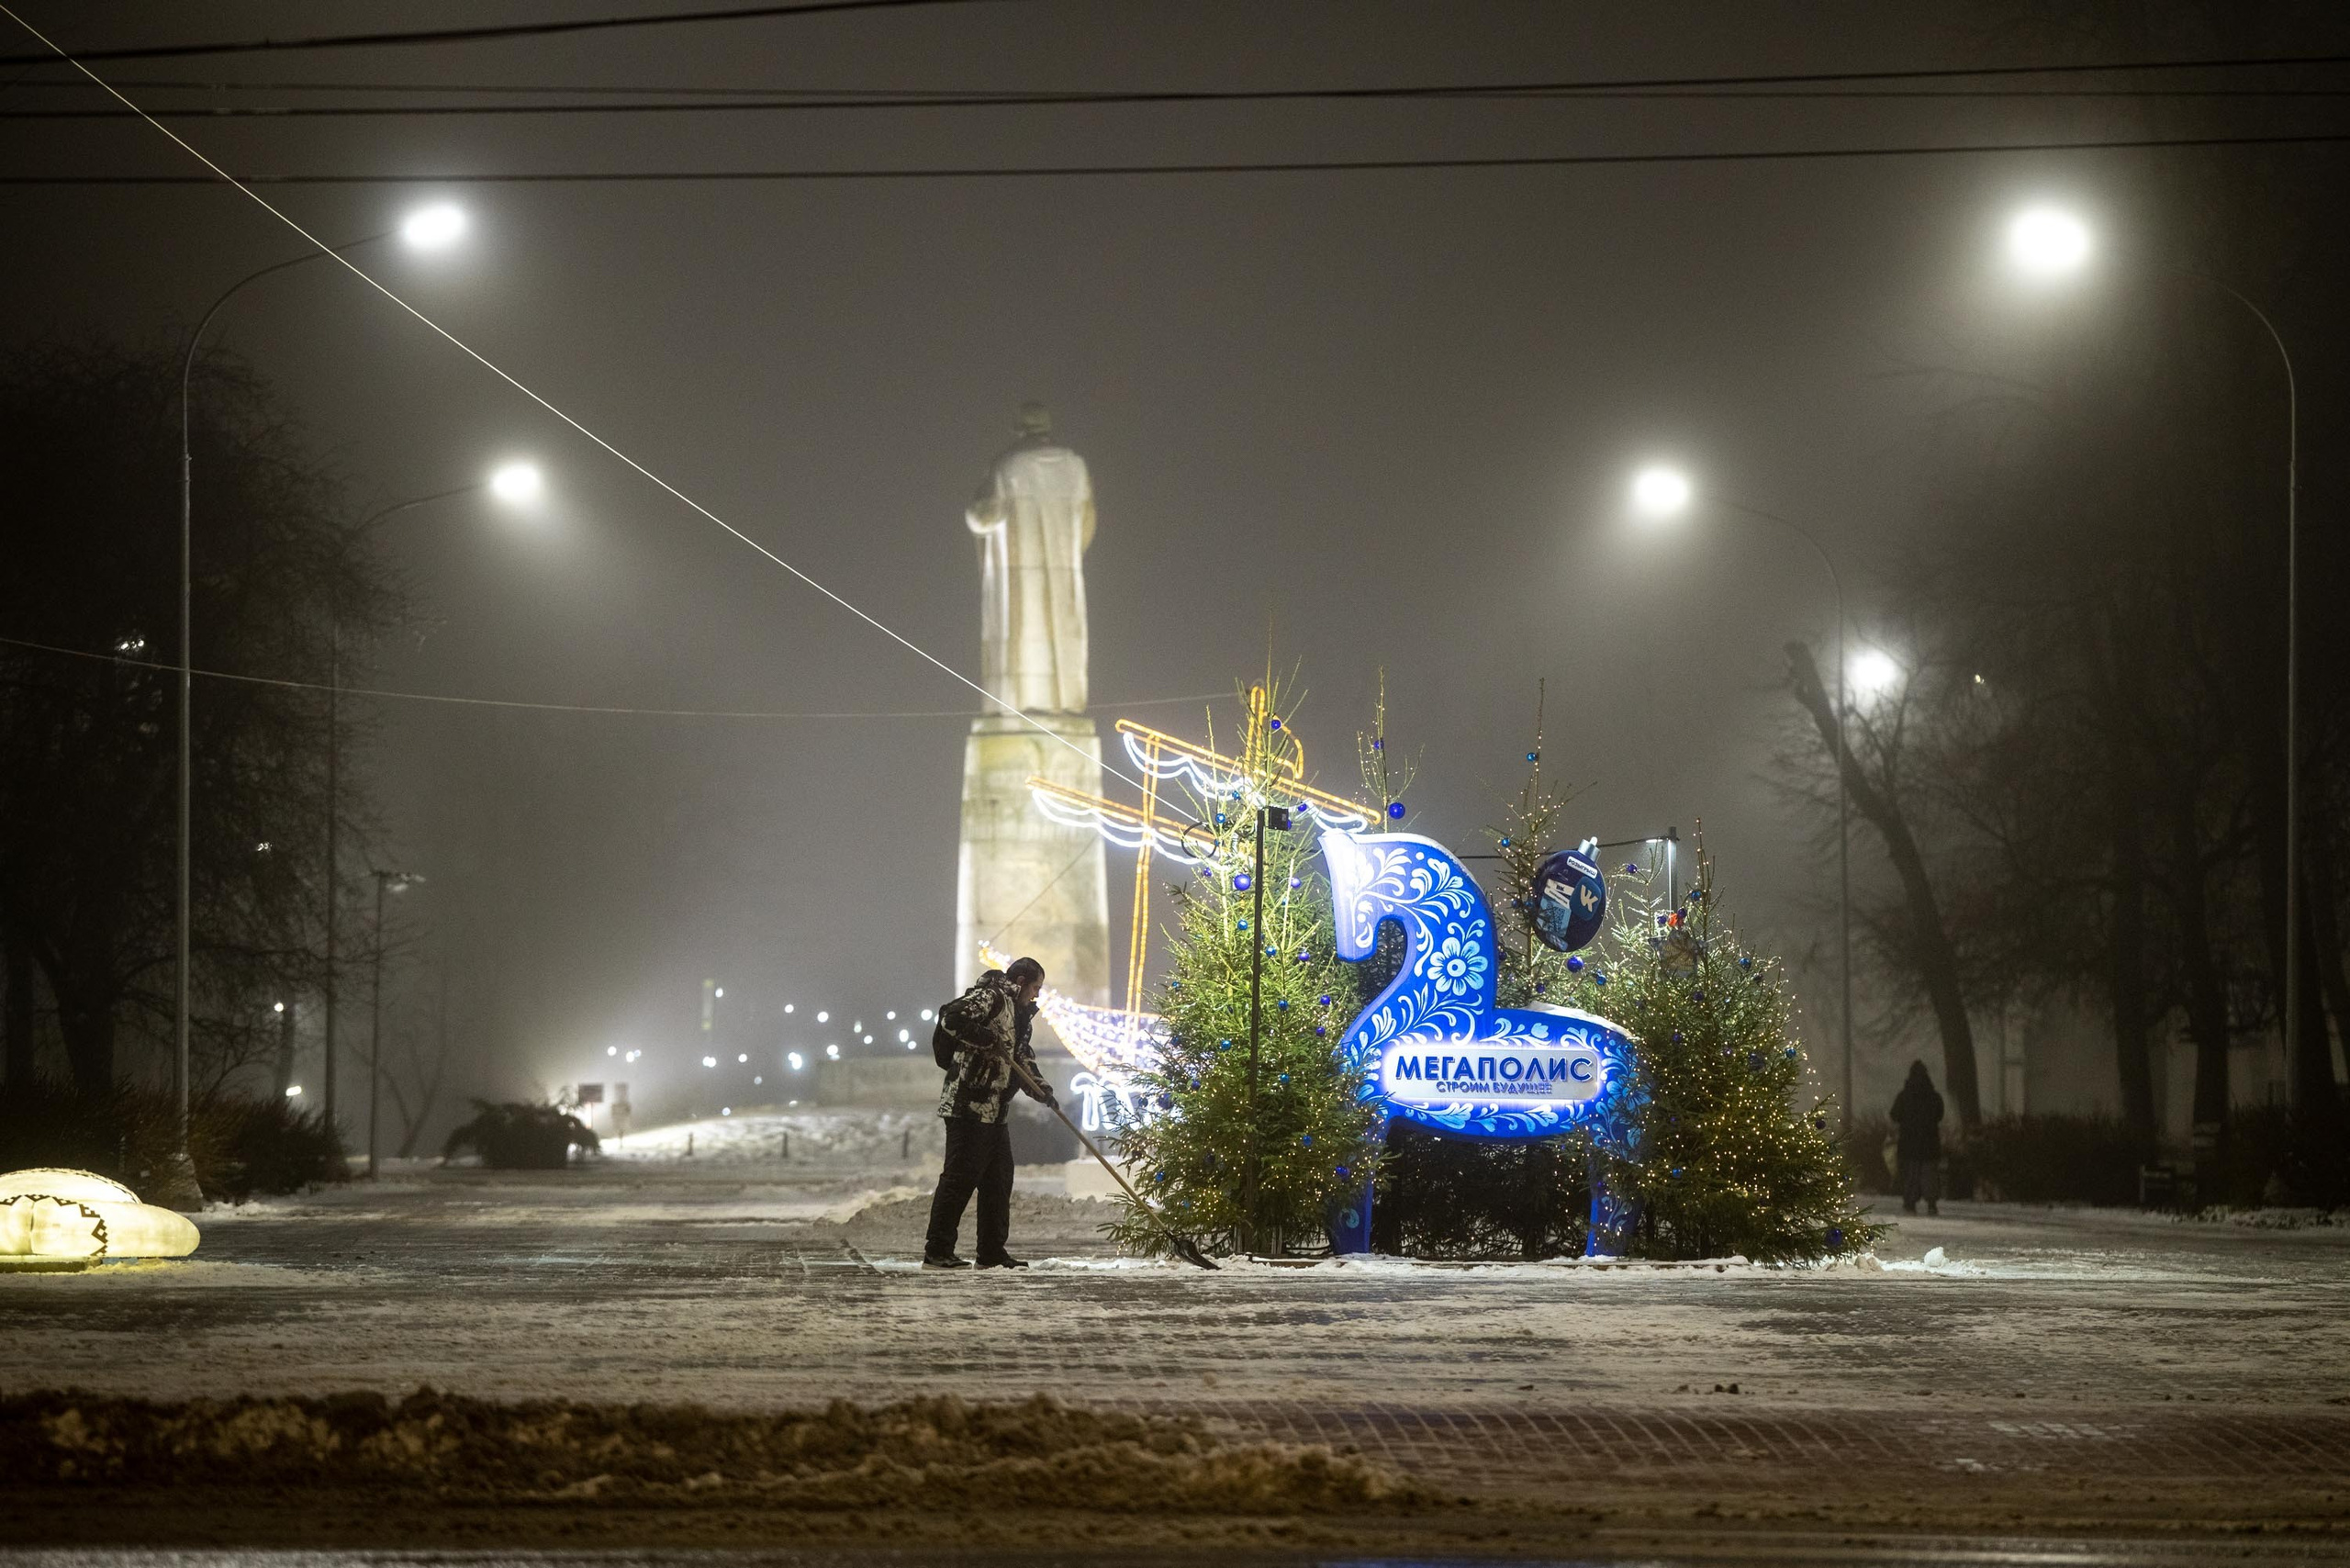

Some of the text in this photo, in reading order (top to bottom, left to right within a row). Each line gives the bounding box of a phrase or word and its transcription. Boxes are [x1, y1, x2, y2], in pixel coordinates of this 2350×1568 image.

[1569, 859, 1595, 876] РОЗЫГРЫШ
[1395, 1056, 1593, 1081] МЕГАПОЛИС
[1437, 1081, 1552, 1094] СТРОИМ БУДУЩЕЕ
